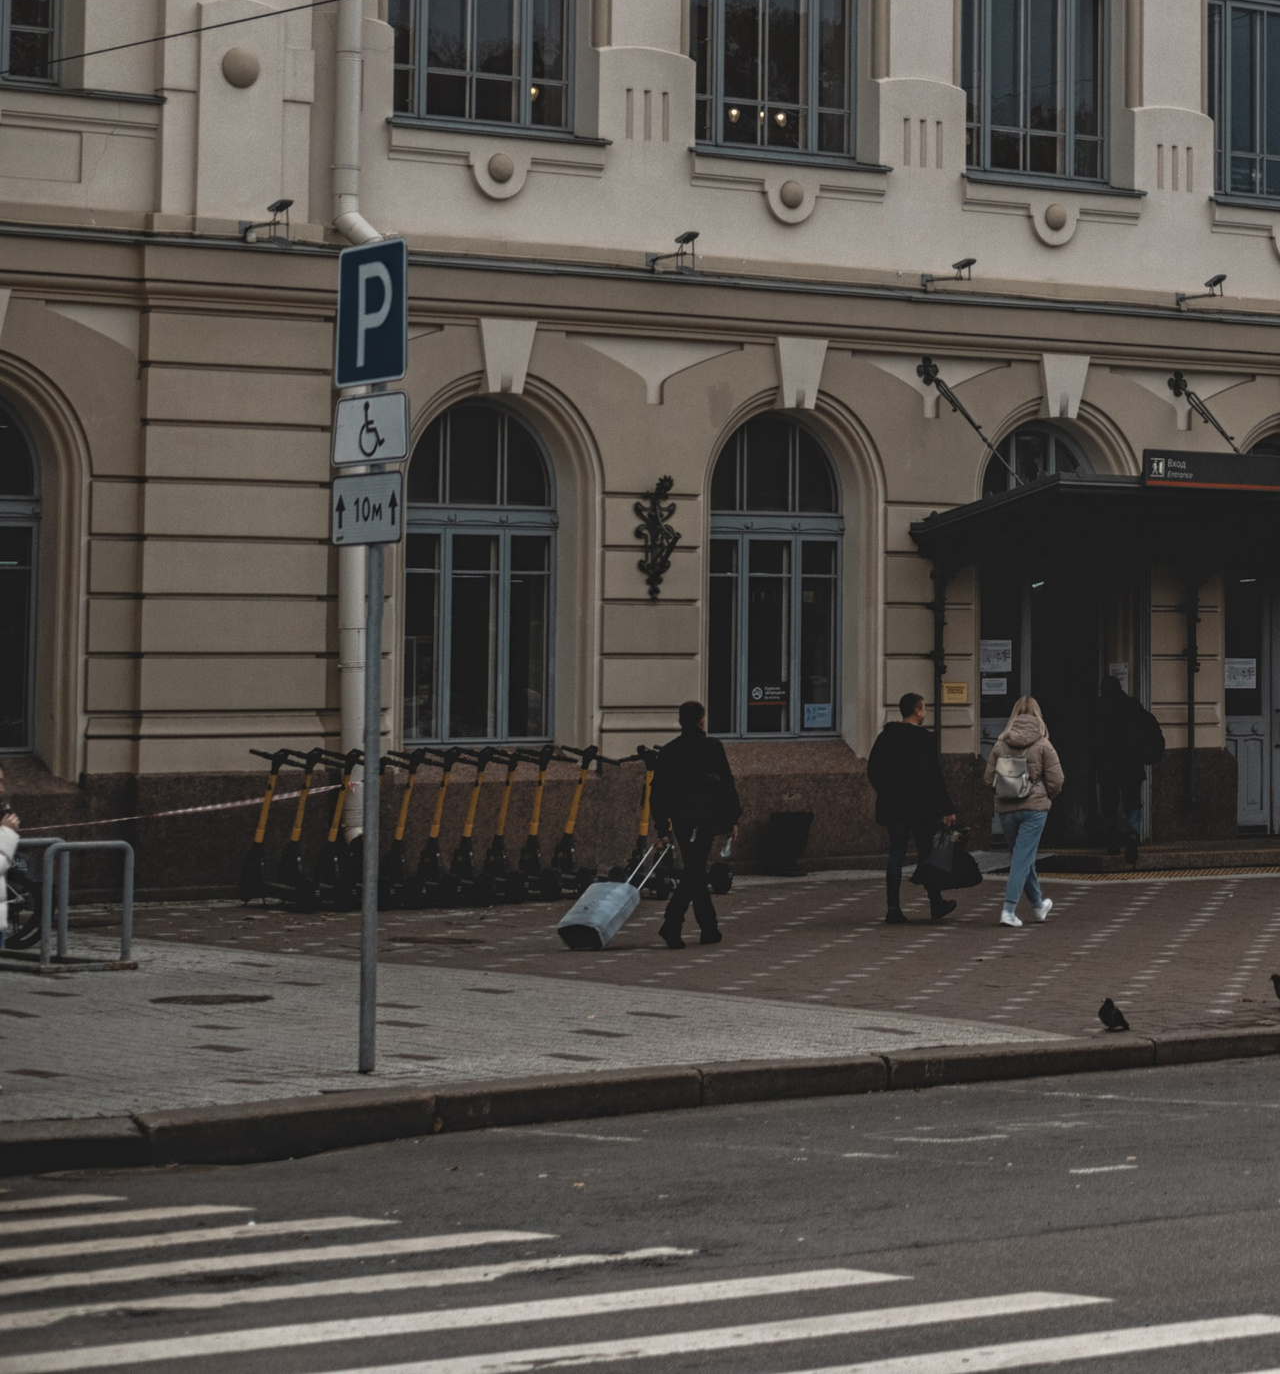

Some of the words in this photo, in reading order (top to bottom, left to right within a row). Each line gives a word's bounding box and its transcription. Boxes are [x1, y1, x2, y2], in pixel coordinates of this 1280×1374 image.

[356, 261, 393, 368] P
[1167, 459, 1186, 469] Вход
[1166, 471, 1194, 479] Entrance
